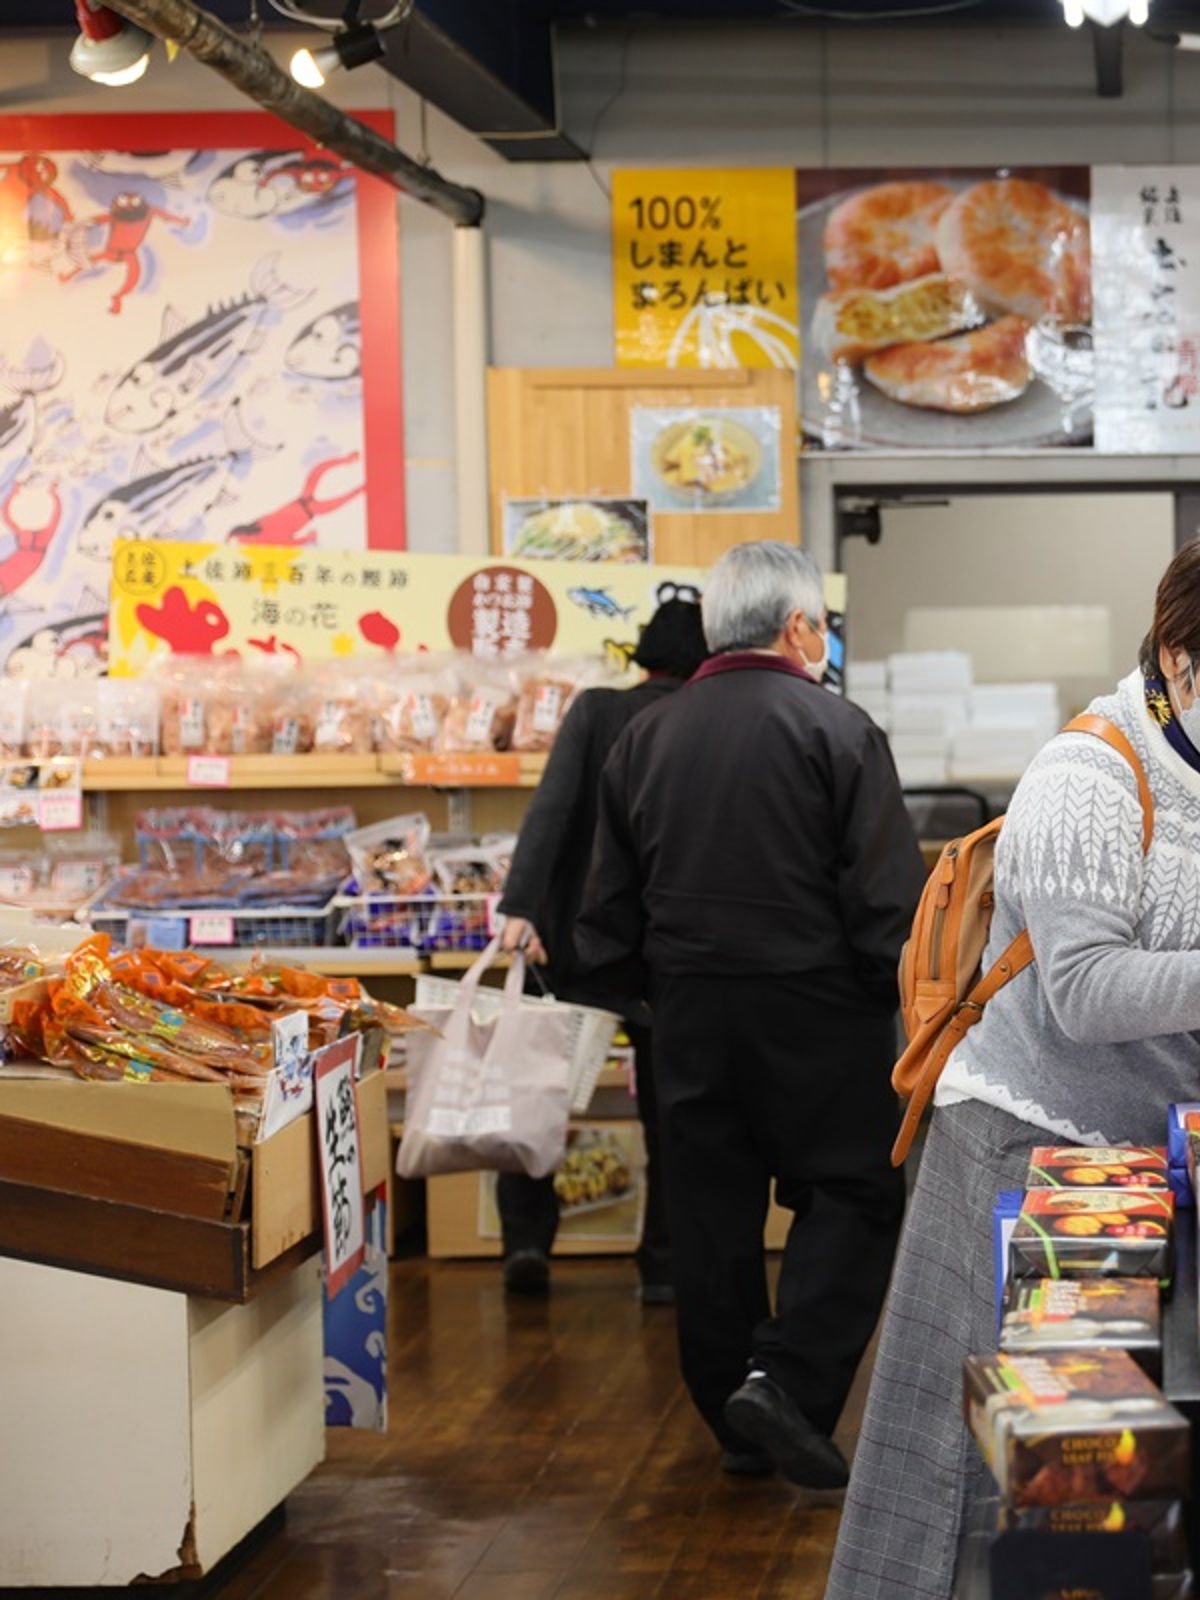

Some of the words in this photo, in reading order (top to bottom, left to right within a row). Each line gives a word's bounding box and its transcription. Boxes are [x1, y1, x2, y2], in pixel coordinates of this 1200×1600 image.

[629, 196, 723, 230] 100%
[630, 239, 749, 268] しまんと
